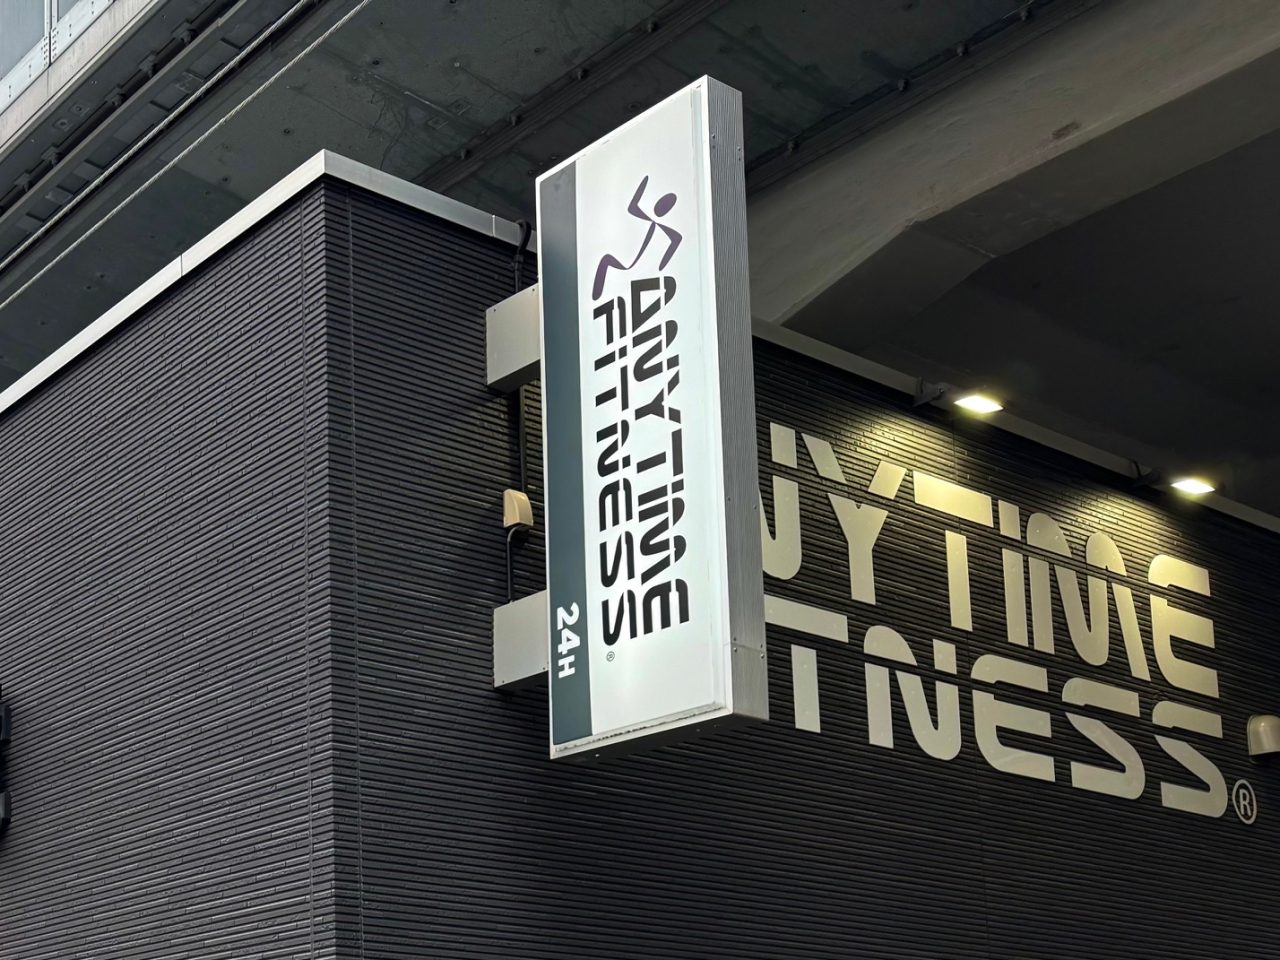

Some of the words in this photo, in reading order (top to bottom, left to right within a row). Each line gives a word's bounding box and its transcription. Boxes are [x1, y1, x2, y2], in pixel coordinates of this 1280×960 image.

[593, 296, 638, 646] FITNESS
[630, 276, 690, 636] ANYTIME
[556, 601, 581, 679] 24H
